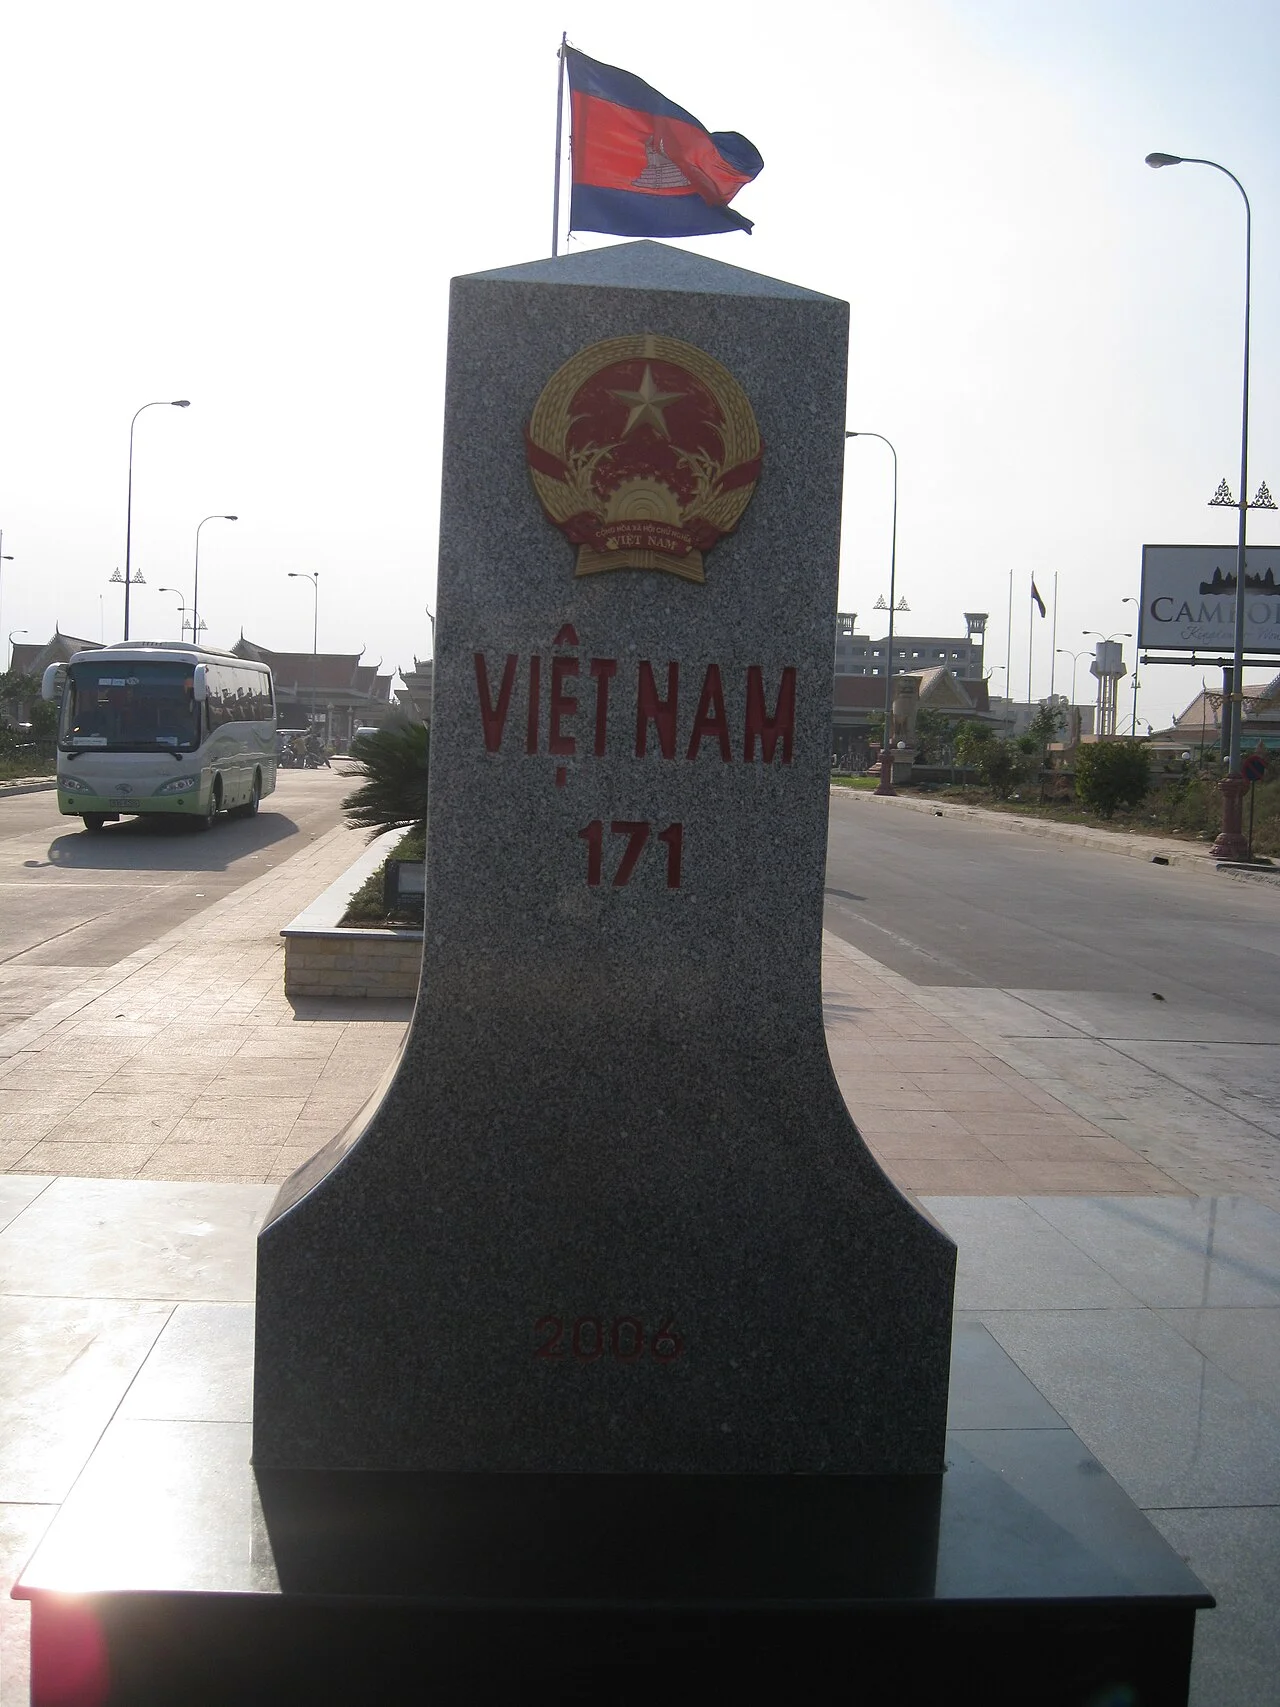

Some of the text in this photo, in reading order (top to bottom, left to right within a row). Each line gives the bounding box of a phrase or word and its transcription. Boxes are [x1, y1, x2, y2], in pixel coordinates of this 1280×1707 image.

[647, 535, 677, 550] NAM
[1150, 596, 1280, 625] CAMO
[473, 623, 798, 788] VIỆT NAM
[578, 819, 683, 889] 171
[533, 1315, 686, 1365] 2006
